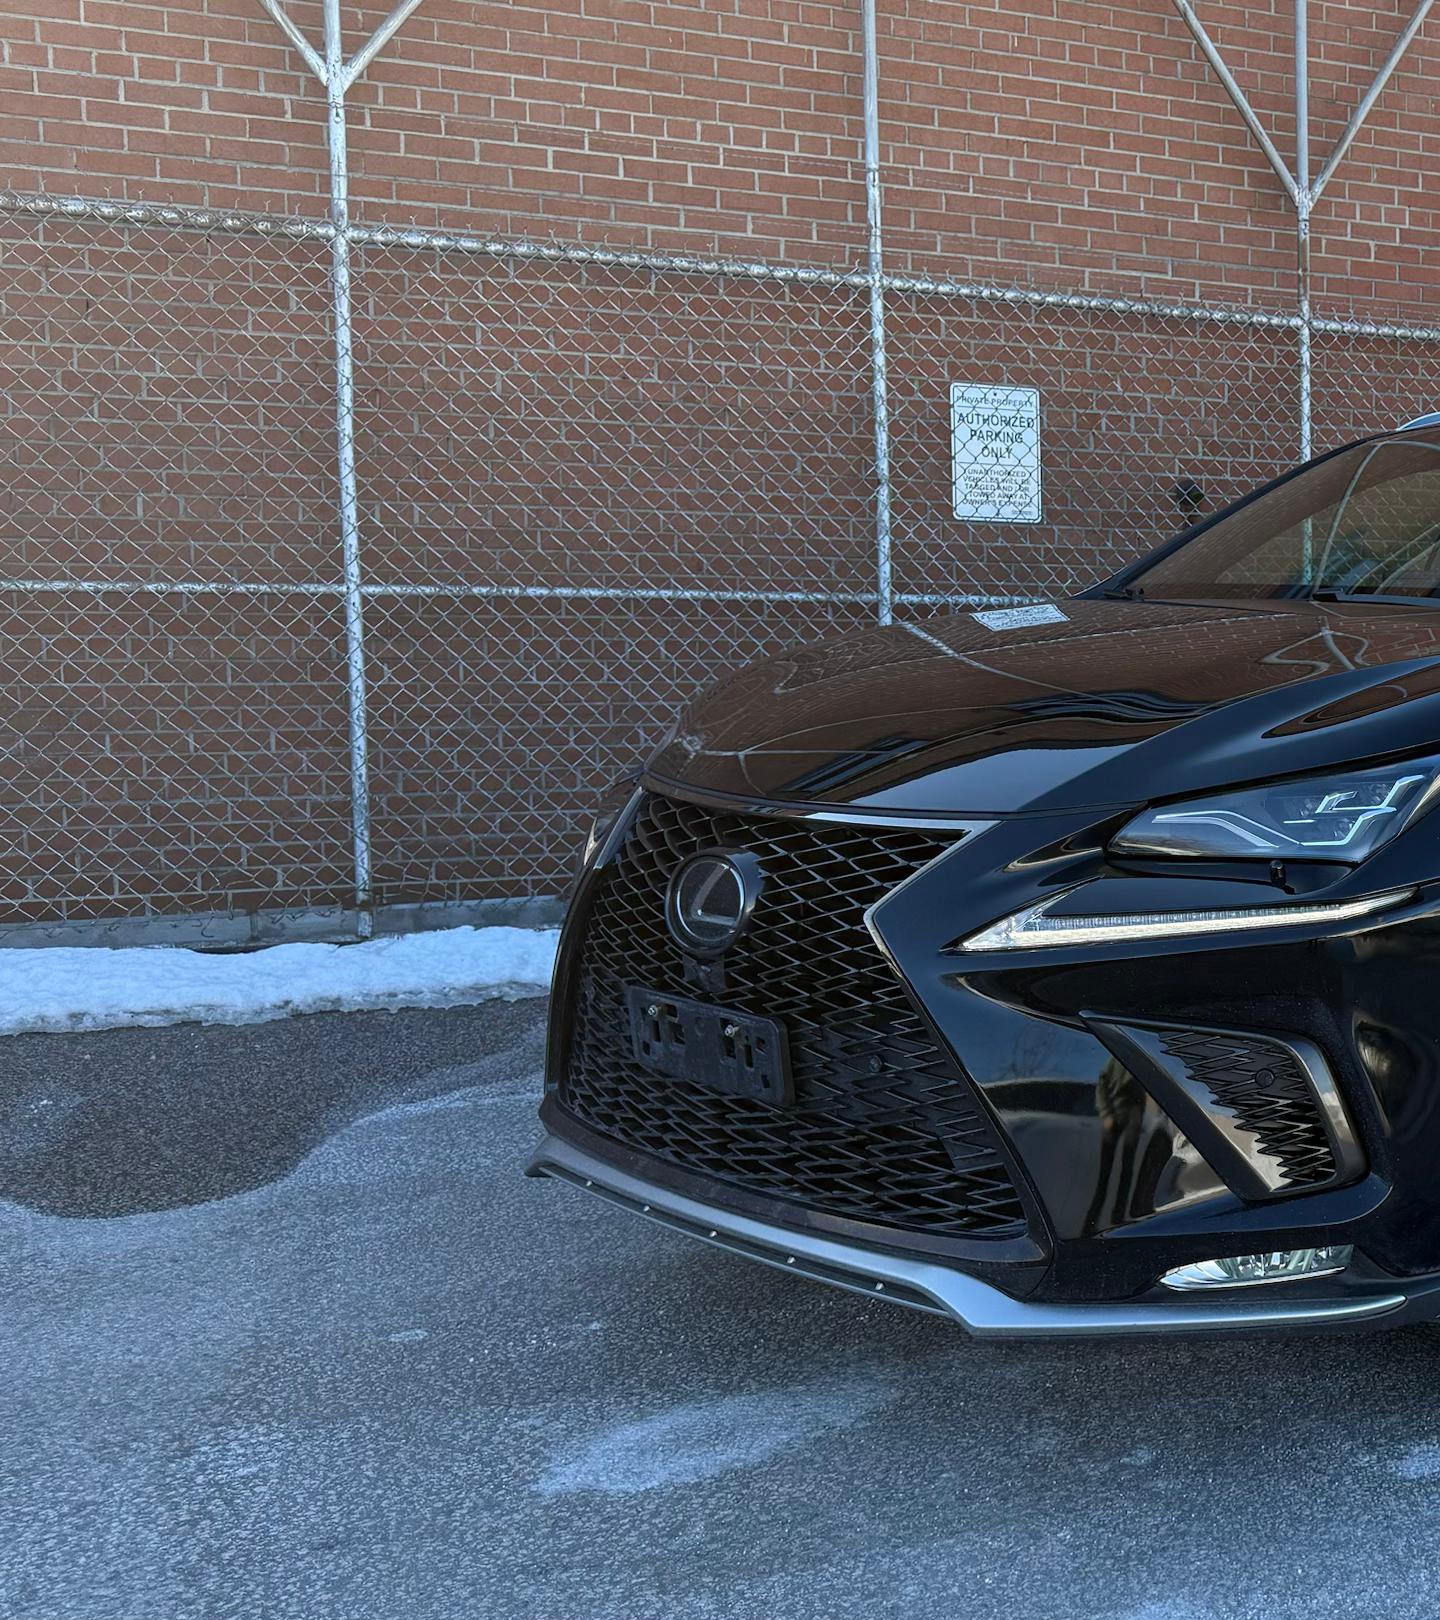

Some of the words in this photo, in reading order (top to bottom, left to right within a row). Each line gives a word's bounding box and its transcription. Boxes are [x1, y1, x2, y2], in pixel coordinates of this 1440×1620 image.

[957, 413, 1034, 428] AUTHORIZED
[970, 430, 1023, 443] PARKING
[981, 445, 1013, 459] ONLY
